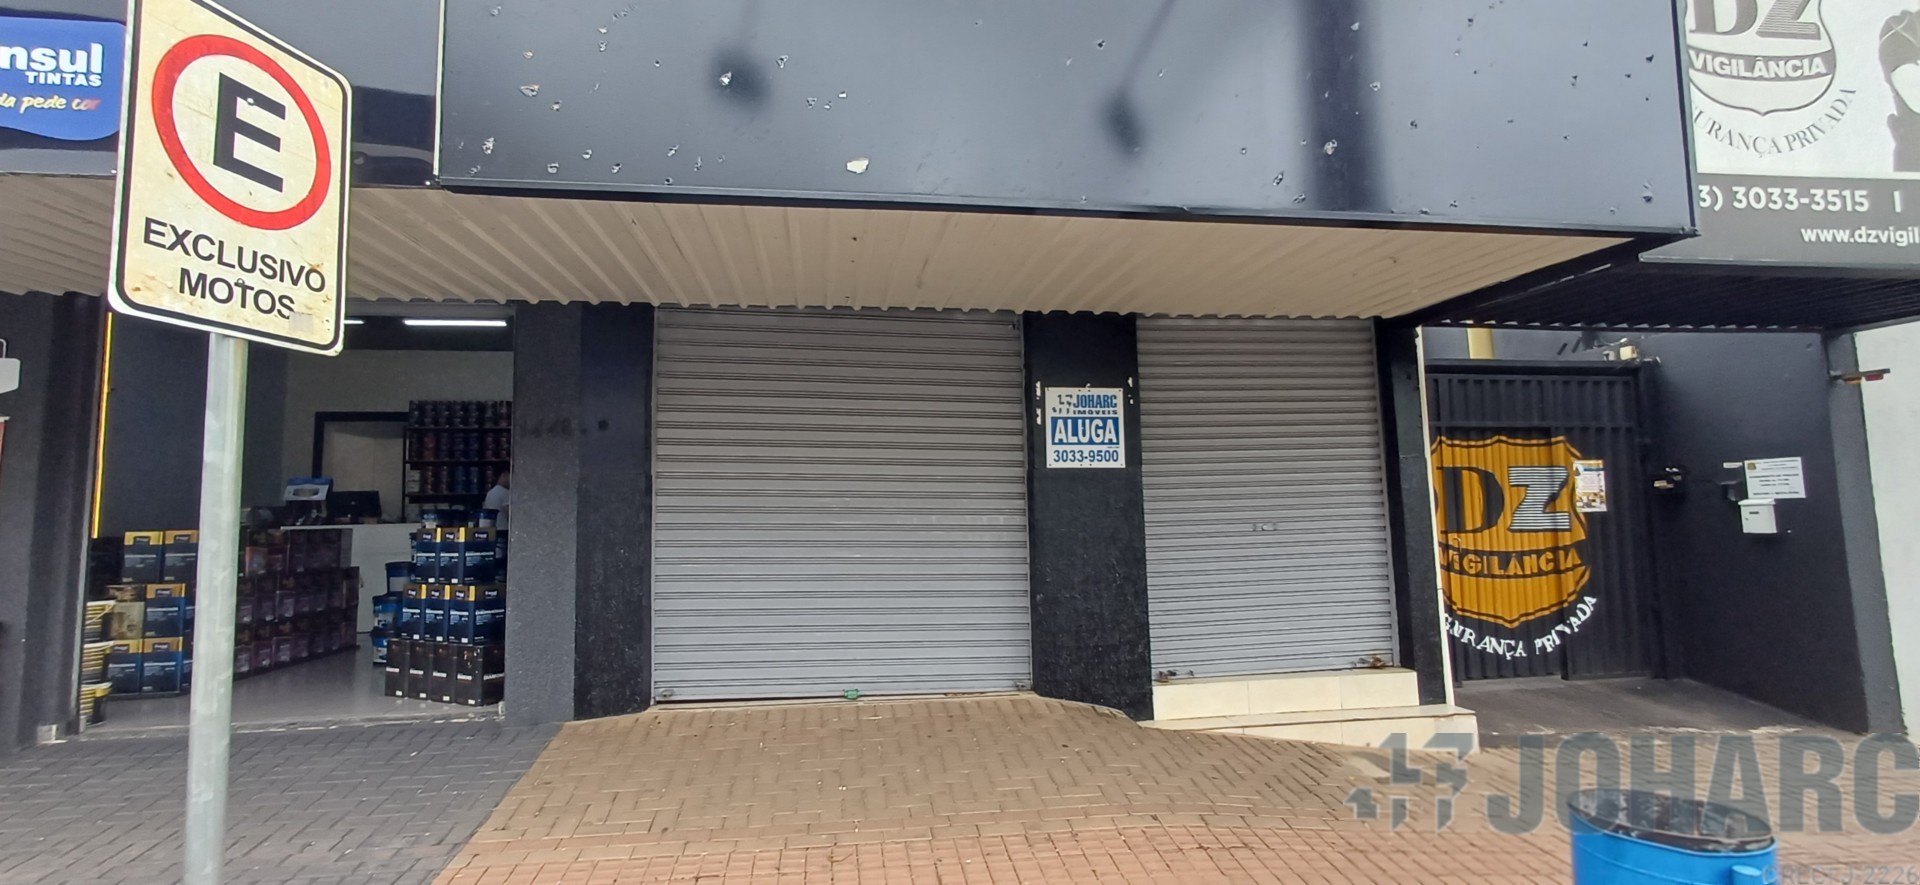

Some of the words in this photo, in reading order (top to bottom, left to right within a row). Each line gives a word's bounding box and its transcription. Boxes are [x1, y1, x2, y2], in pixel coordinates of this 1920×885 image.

[0, 42, 104, 74] nsul
[1688, 49, 1827, 78] VIGILÂNCIA
[25, 71, 103, 87] TINTAS
[19, 95, 67, 114] pede
[213, 72, 286, 193] E
[1784, 88, 1857, 153] PRIVADA
[1732, 186, 1870, 213] 3033-3515
[1801, 226, 1920, 247] www.dzvigil
[143, 216, 326, 293] EXCLUSIVO
[179, 267, 296, 320] MOTOS
[1073, 394, 1117, 408] JOHARC
[1054, 419, 1117, 443] ALUGA
[1053, 449, 1119, 463] 3033-9500
[1437, 465, 1572, 533] DZ
[1534, 595, 1597, 655] PRIVADA
